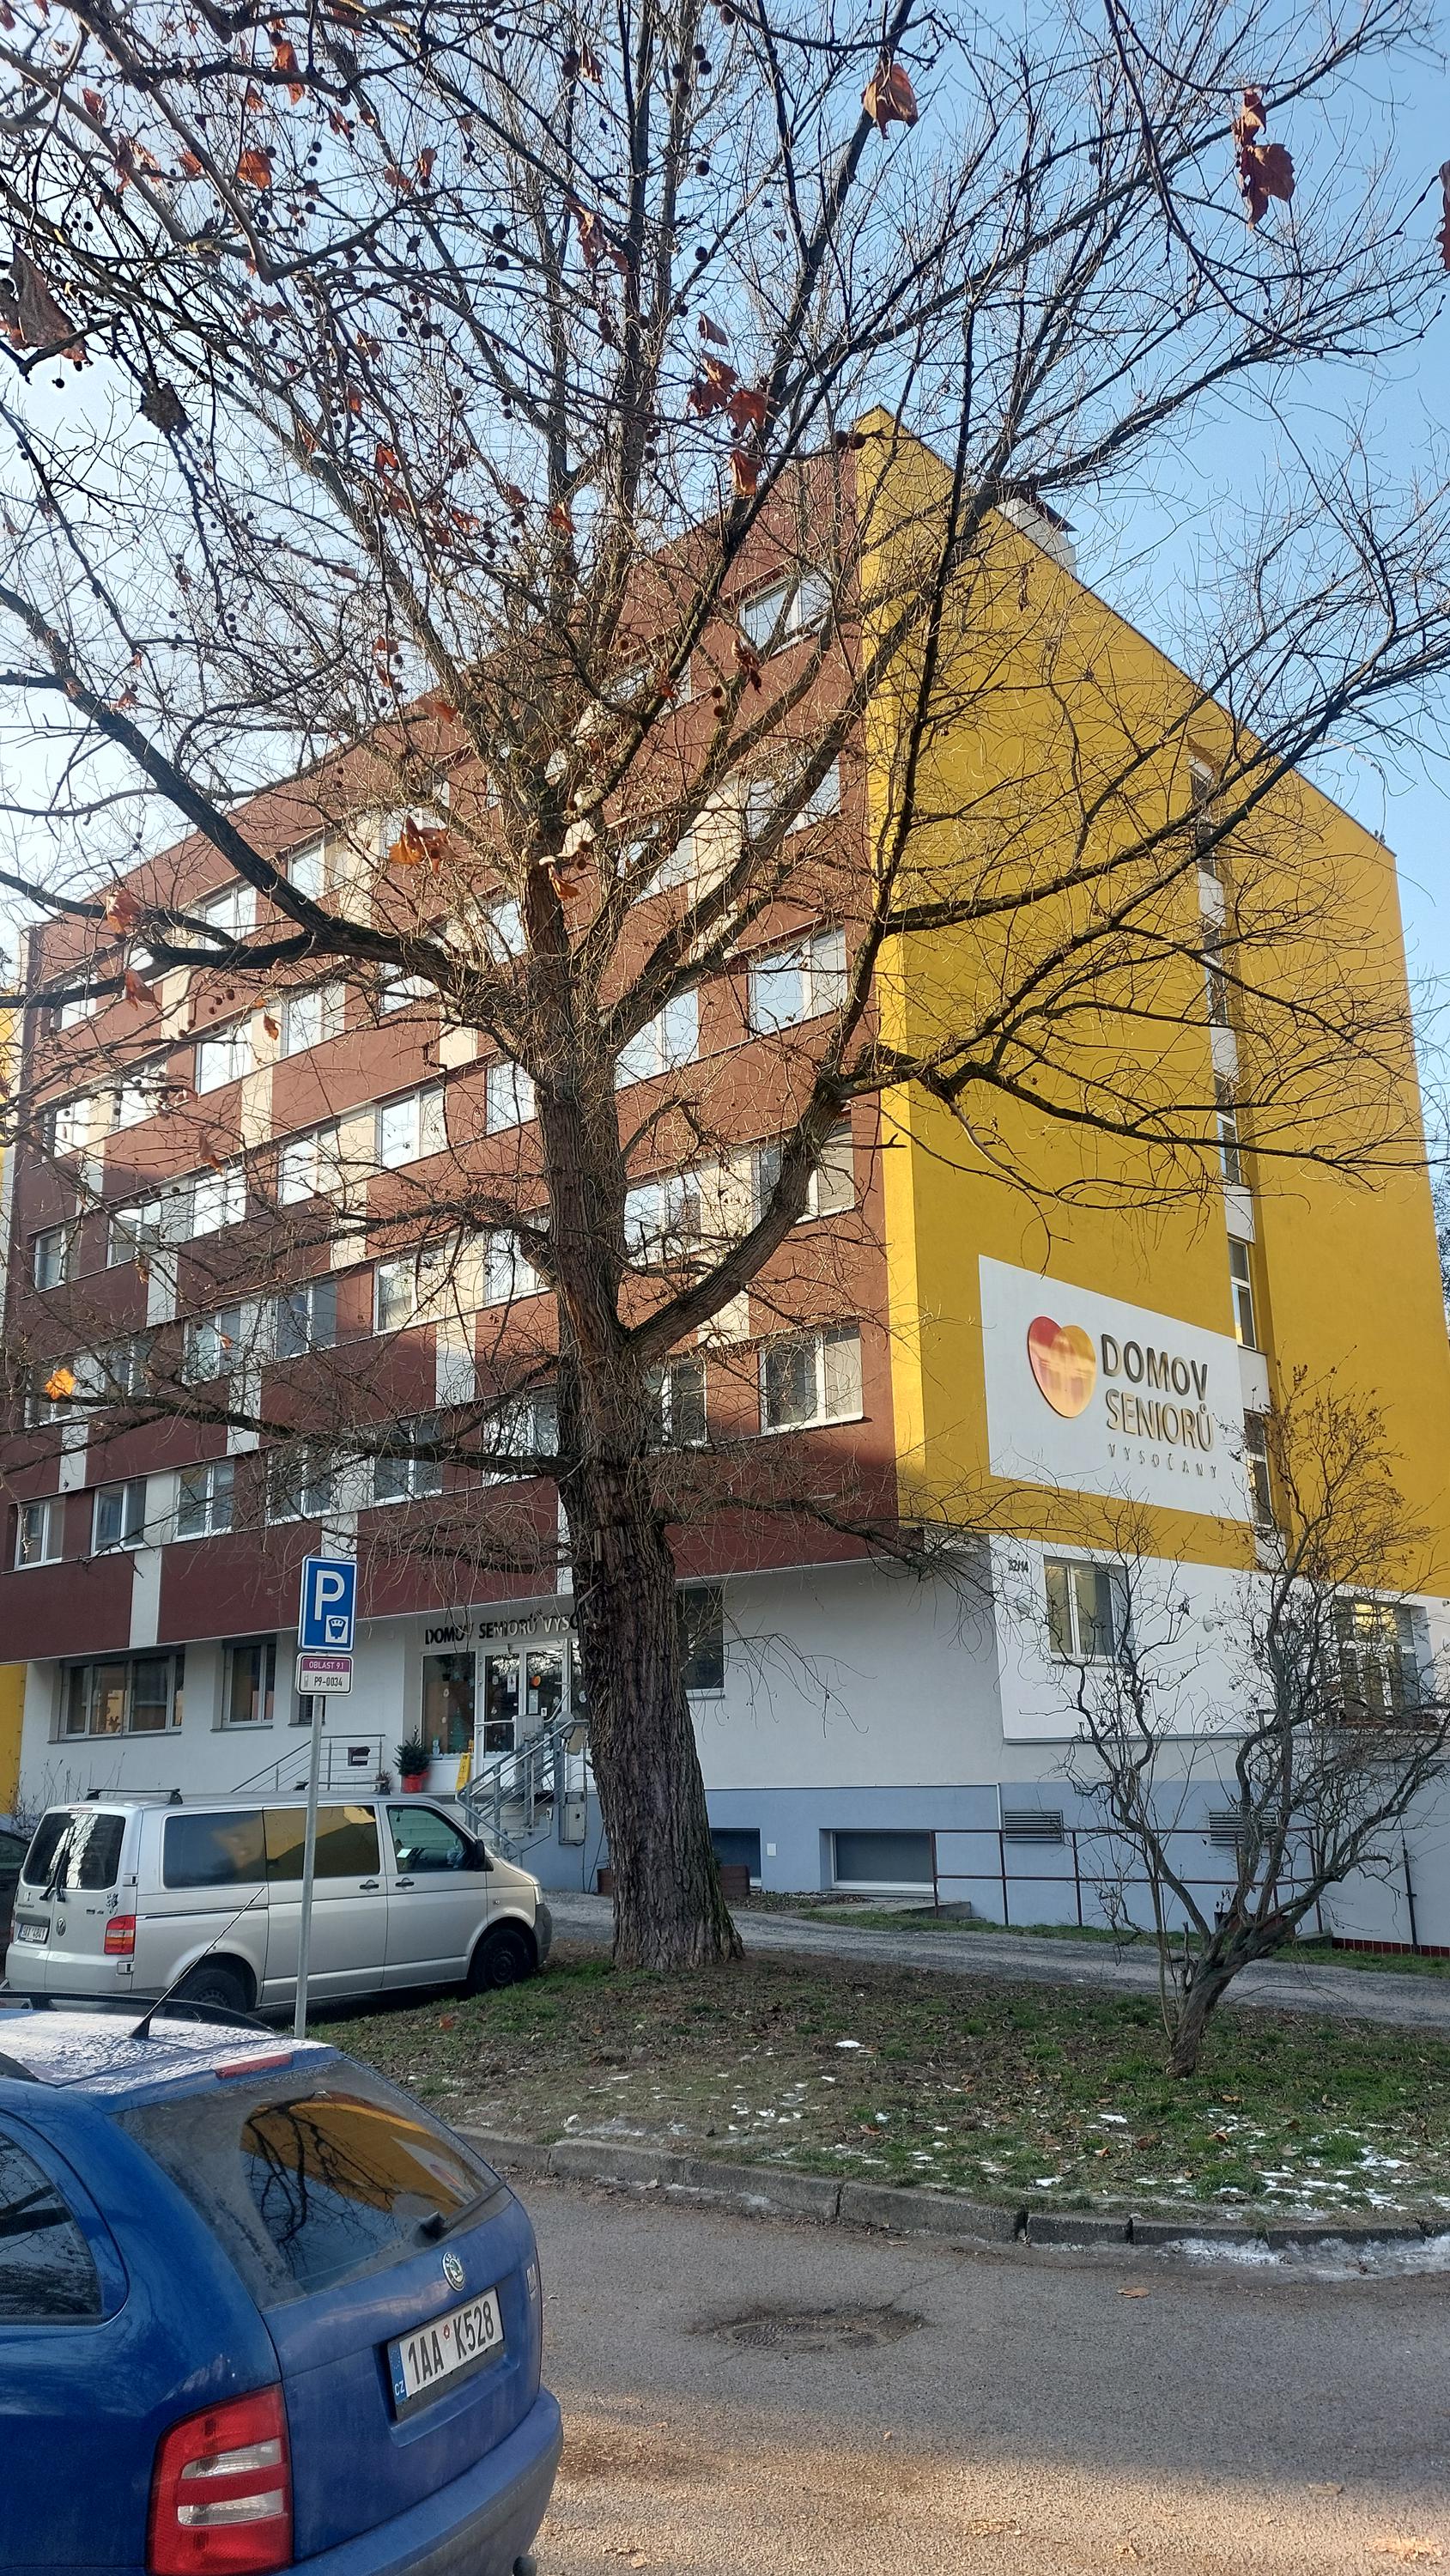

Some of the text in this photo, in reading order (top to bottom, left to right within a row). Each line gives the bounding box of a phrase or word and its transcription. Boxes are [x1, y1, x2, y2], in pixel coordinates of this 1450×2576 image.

[1101, 1334, 1208, 1400] DOMOV
[1106, 1388, 1214, 1451] SENIORŮ
[1108, 1443, 1217, 1479] VYSOČANY
[314, 1571, 345, 1620] P
[314, 1676, 343, 1686] P9-0034
[408, 2300, 494, 2385] 1AA K528
[394, 2381, 405, 2396] CZ
